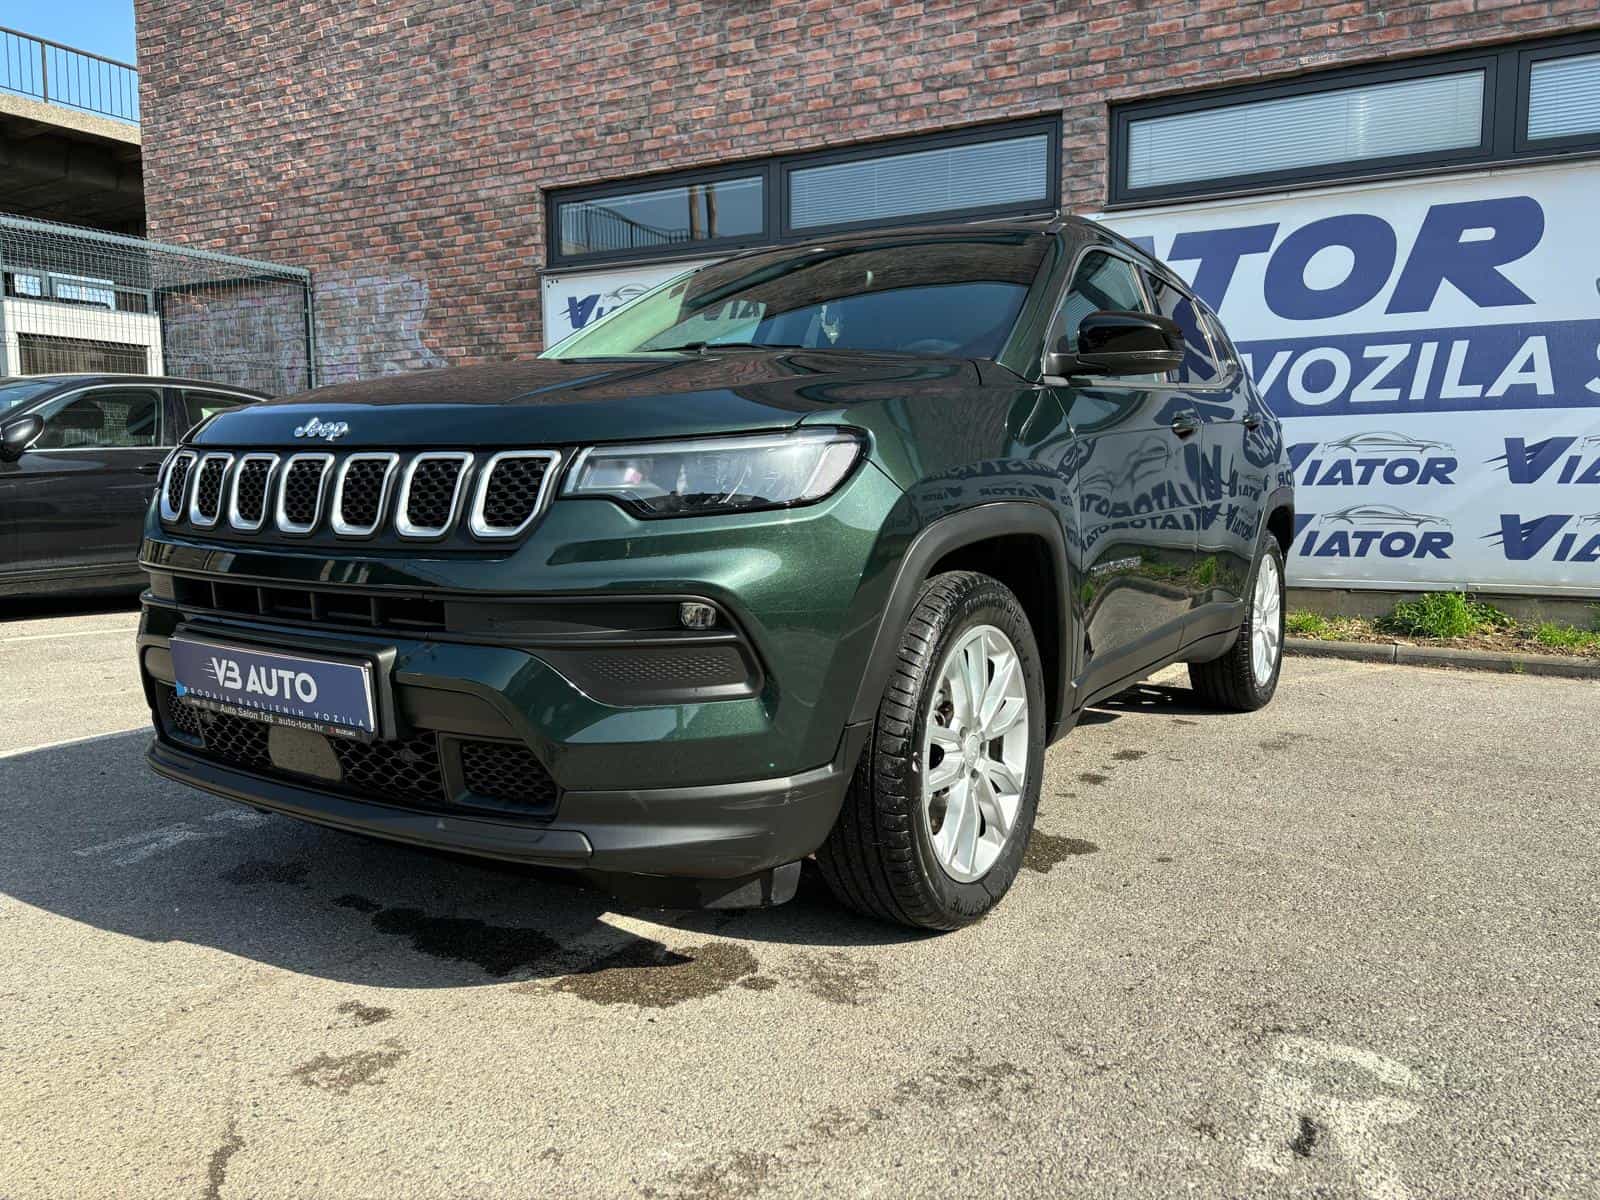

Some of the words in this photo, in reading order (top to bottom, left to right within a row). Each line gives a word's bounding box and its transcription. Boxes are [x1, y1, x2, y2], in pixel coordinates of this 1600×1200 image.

[1130, 195, 1545, 321] TOR
[1241, 335, 1555, 406] VOZILA
[294, 417, 348, 441] Jeep
[211, 656, 242, 690] VB
[246, 664, 318, 703] AUTO
[220, 703, 237, 715] Auto
[238, 706, 258, 720] Salon
[313, 711, 365, 727] VOZILA
